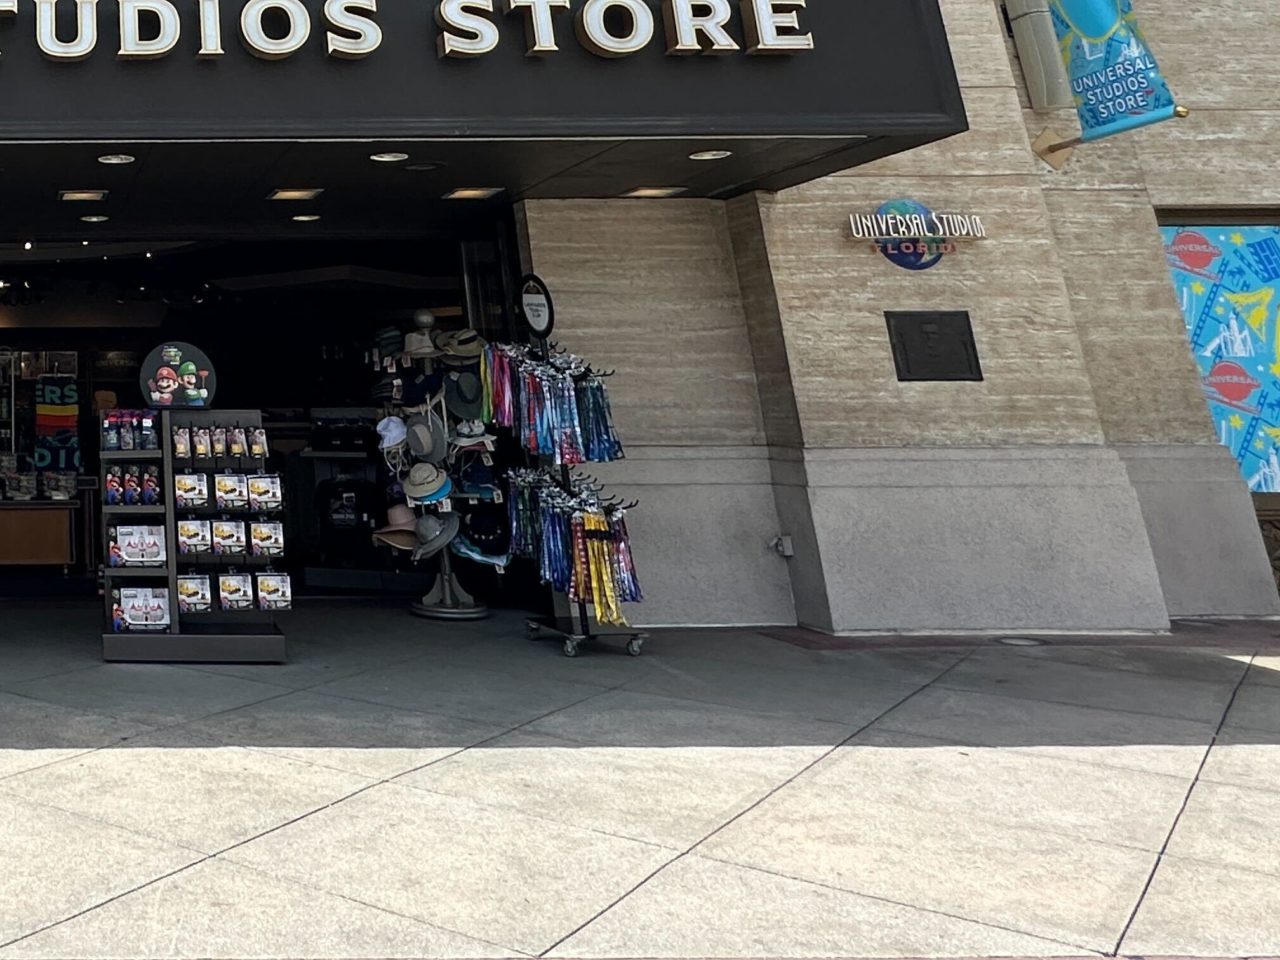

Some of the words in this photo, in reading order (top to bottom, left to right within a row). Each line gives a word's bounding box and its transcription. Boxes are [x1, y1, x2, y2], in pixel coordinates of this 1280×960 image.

[1072, 55, 1155, 94] UNIVERSAL
[1087, 73, 1148, 105] STUDIOS
[1098, 93, 1148, 118] STORE
[849, 213, 933, 238] UNIVERSAL
